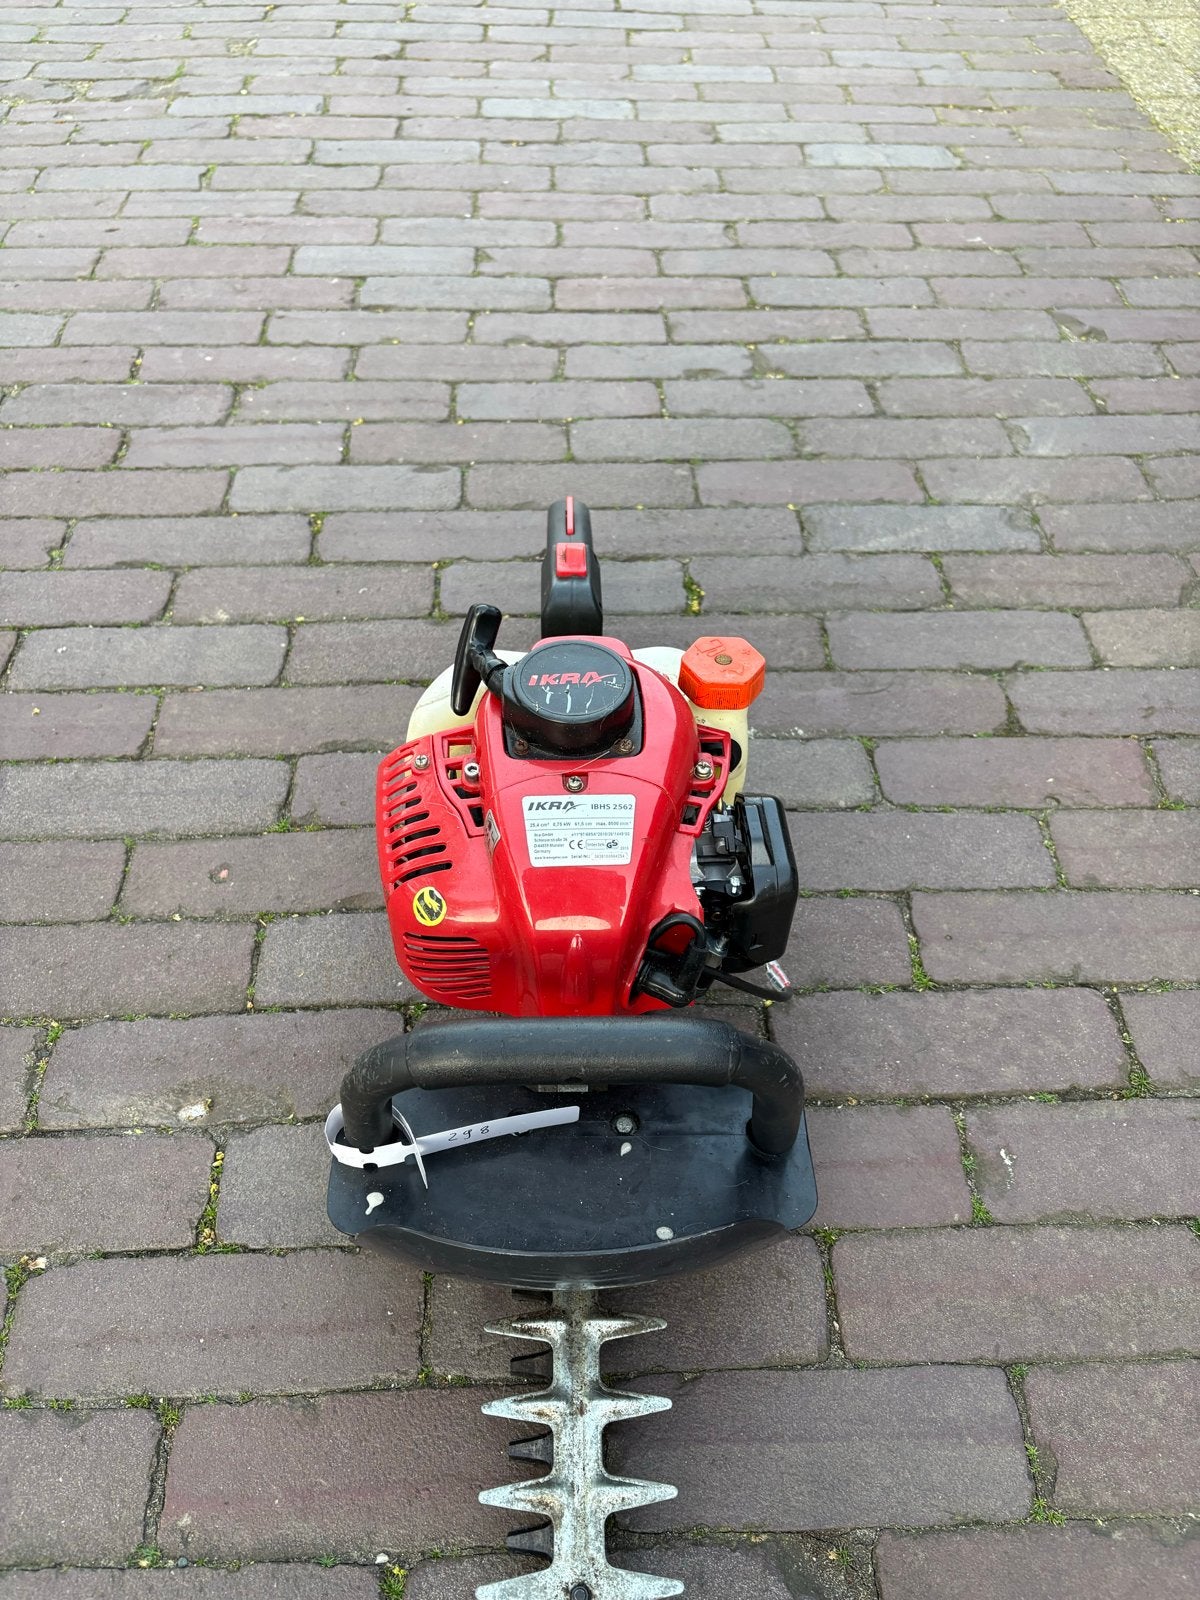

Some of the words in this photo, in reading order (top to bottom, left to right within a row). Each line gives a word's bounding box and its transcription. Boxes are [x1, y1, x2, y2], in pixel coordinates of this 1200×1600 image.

[528, 671, 618, 688] IKRA
[528, 801, 588, 814] IKRA
[448, 1125, 490, 1142] 298
